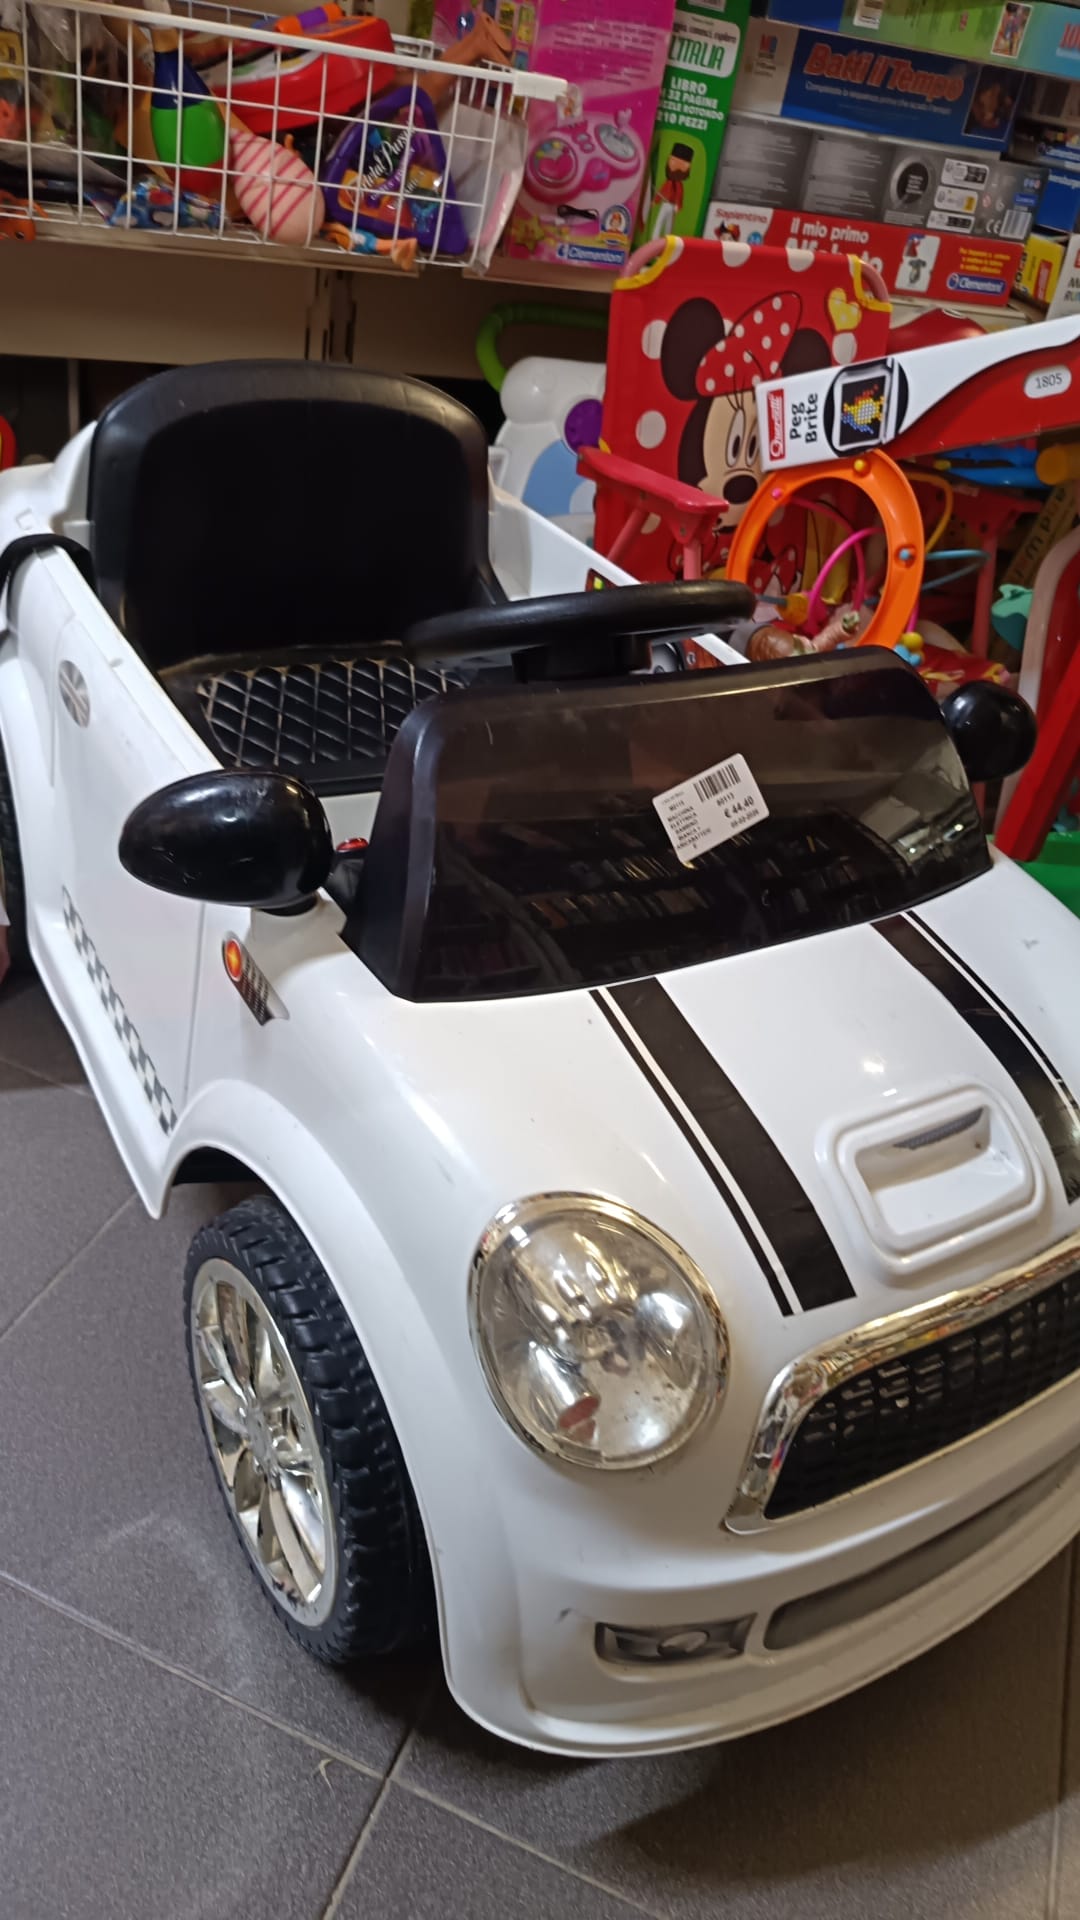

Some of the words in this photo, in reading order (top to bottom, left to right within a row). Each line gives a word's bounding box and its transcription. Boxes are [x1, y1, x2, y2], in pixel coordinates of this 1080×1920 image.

[803, 42, 874, 84] Batti
[867, 52, 889, 88] il
[886, 56, 965, 102] Tempo
[671, 77, 707, 95] LIBRO
[683, 92, 718, 109] PAGINE
[683, 104, 724, 120] ROTONDO
[679, 115, 708, 131] PEZZI
[715, 208, 768, 224] Sapientino
[802, 221, 827, 238] mio
[830, 226, 869, 244] primo
[569, 247, 623, 264] Clementoni
[959, 277, 1004, 294] Clementoni
[1035, 373, 1063, 389] 1805
[789, 402, 805, 440] Peg
[804, 392, 818, 443] Brite
[732, 796, 754, 814] 44,40
